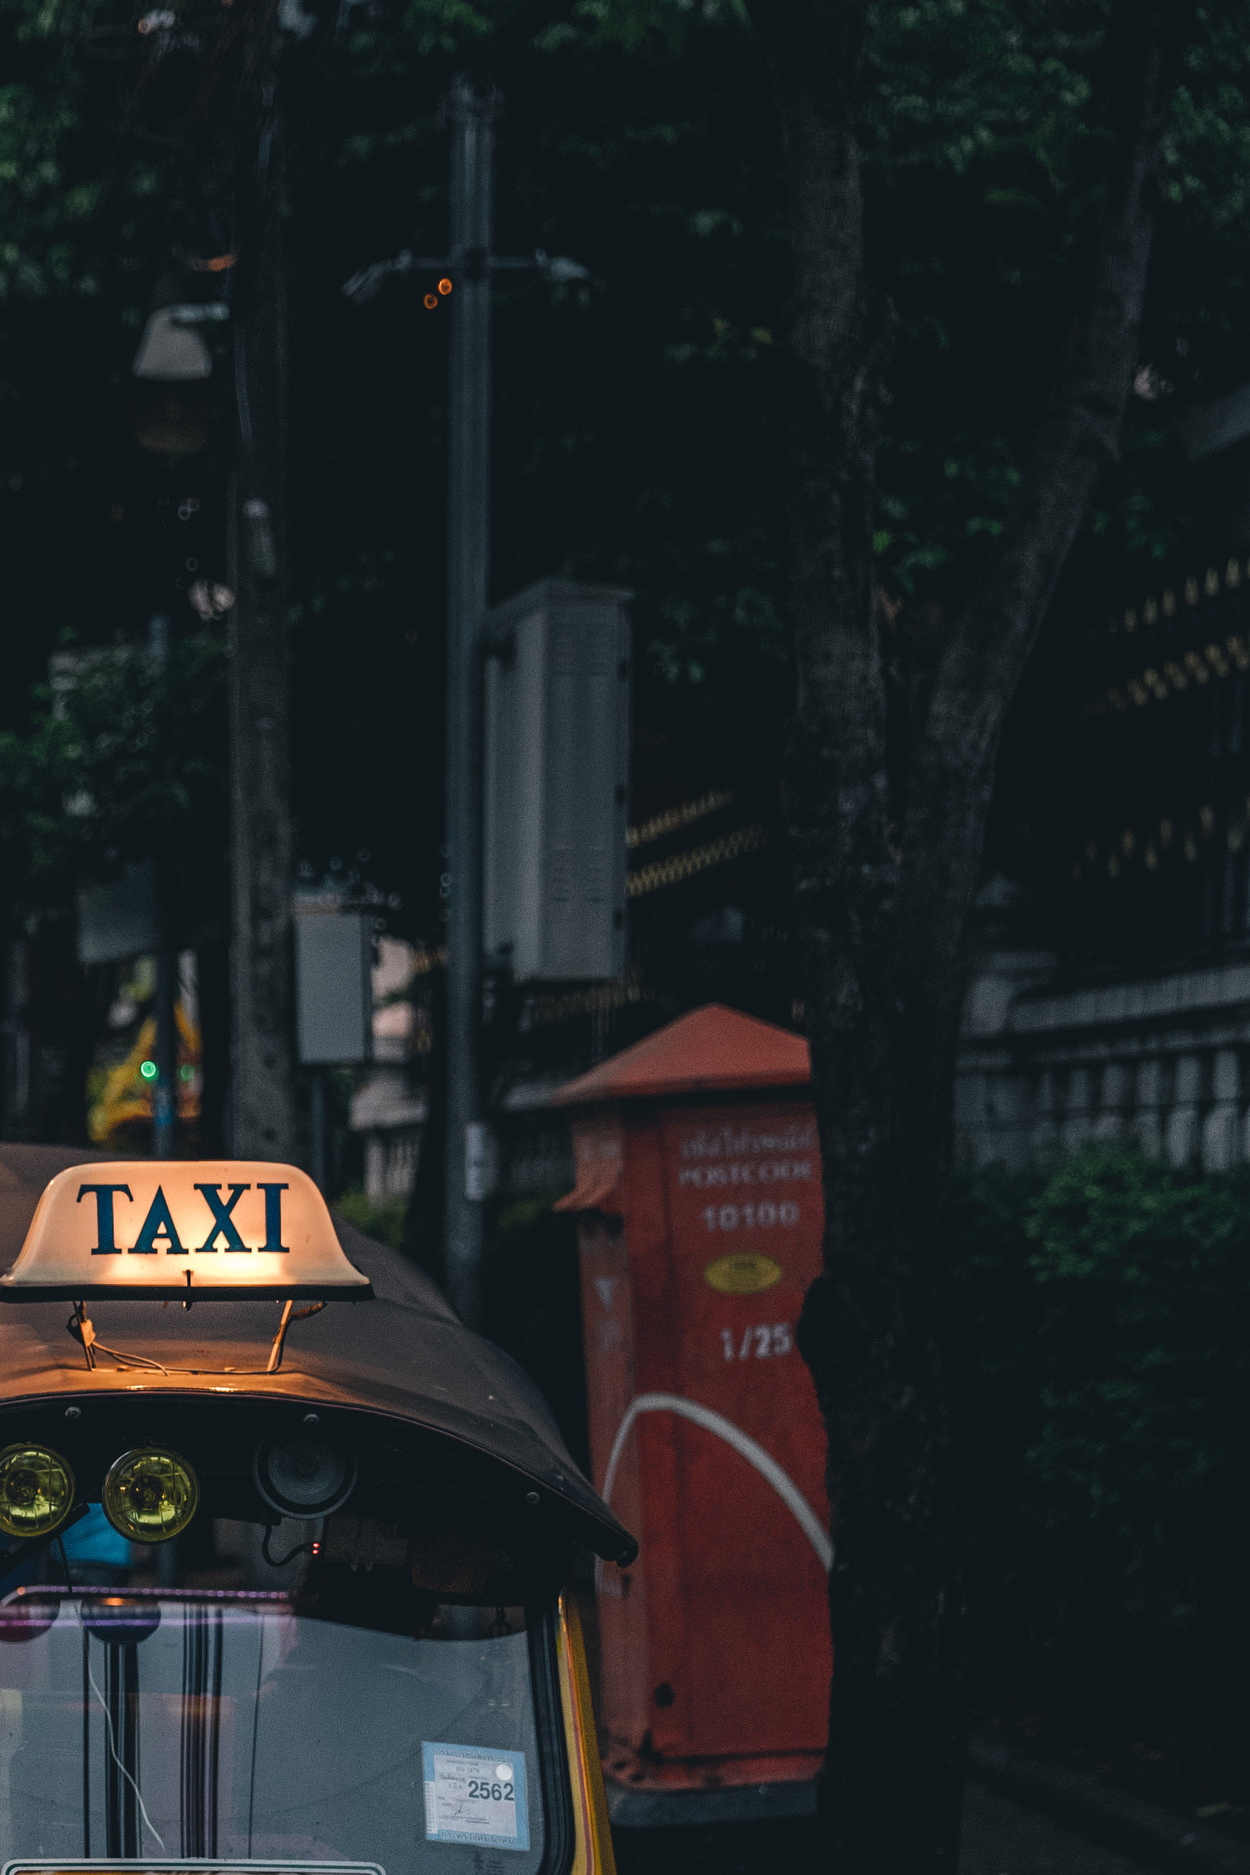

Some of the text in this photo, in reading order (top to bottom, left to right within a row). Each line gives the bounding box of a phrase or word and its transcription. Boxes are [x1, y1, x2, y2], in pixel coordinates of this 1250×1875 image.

[76, 1183, 290, 1255] TAXI
[702, 1201, 800, 1231] 10100
[719, 1321, 792, 1362] 1/25
[468, 1780, 515, 1801] 2562
